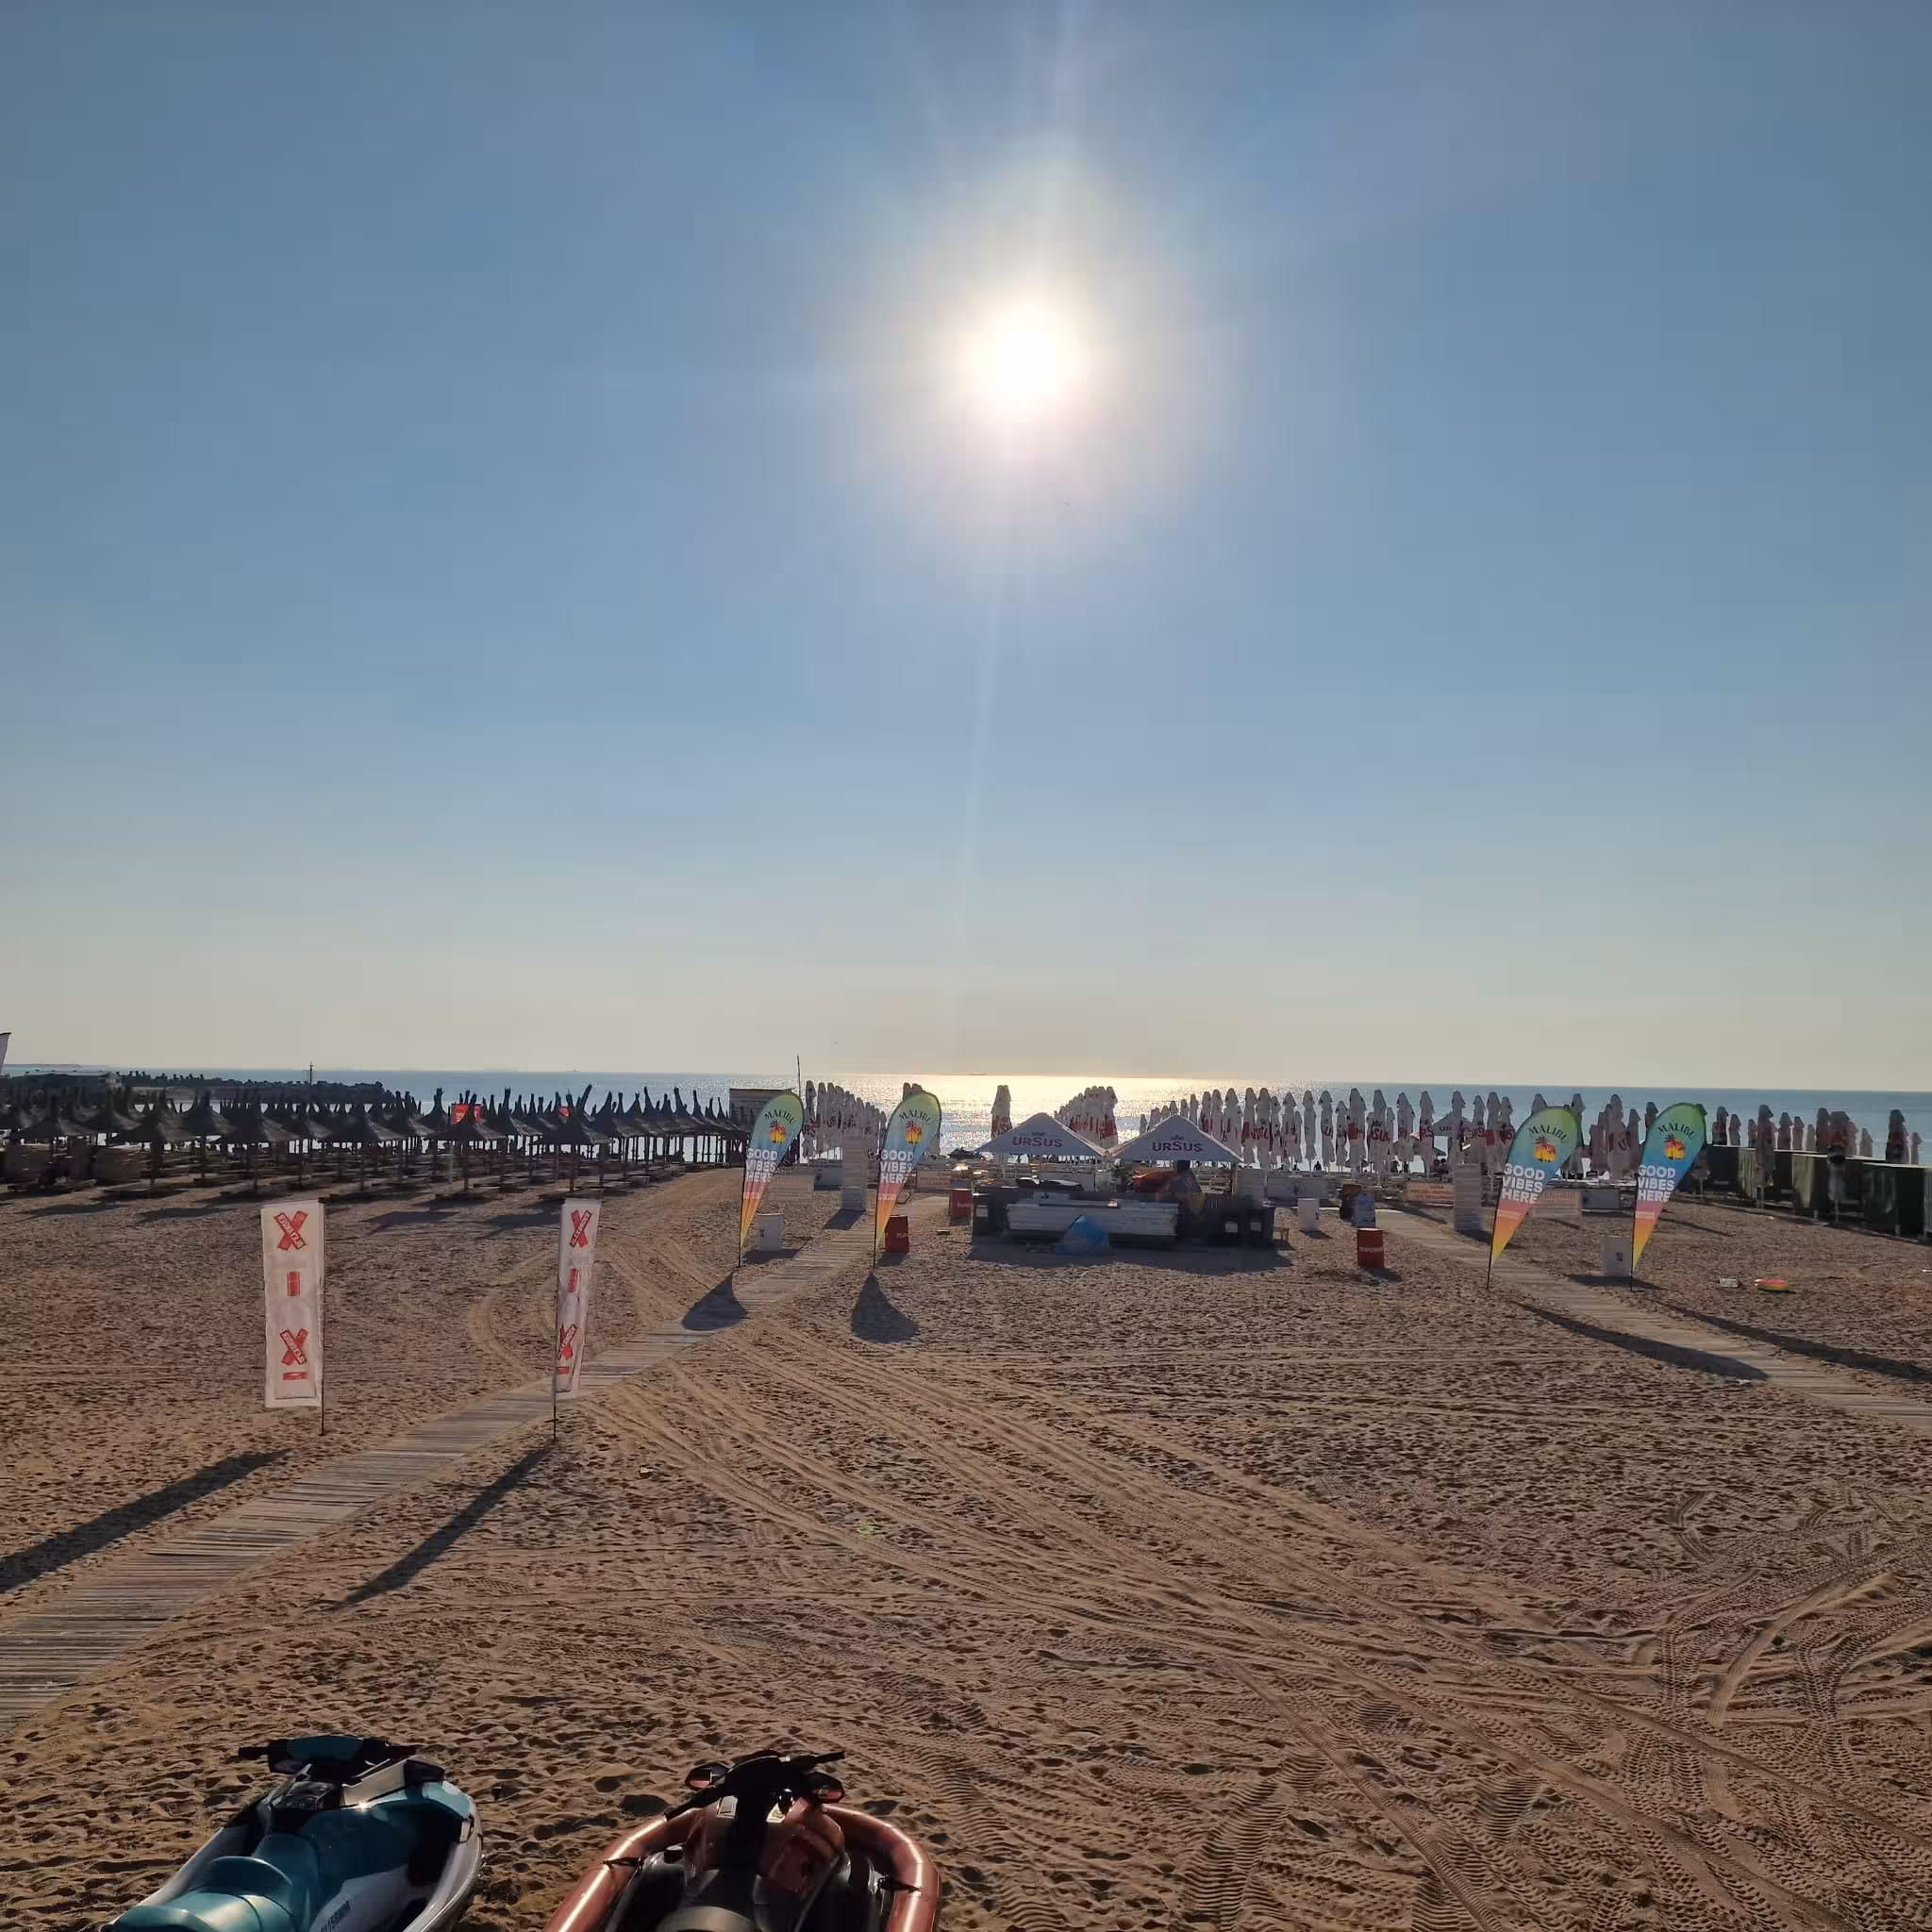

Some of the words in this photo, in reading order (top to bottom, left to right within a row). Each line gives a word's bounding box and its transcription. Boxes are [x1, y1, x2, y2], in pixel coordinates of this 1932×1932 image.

[764, 1108, 796, 1124] MALIBU
[899, 1109, 931, 1124] MALIBU
[1529, 1124, 1570, 1143] MALIBU
[1657, 1122, 1697, 1141] MALIBU
[1012, 1136, 1063, 1149] URSUS
[1152, 1141, 1204, 1153] URSUS
[746, 1148, 778, 1160] GOOD
[881, 1149, 914, 1161] GOOD
[746, 1160, 777, 1173] VIBES
[880, 1161, 913, 1173] VIBES
[1504, 1163, 1545, 1181] GOOD
[1639, 1164, 1676, 1178] GOOD
[746, 1172, 774, 1183] HERE
[1502, 1175, 1543, 1193] VIBES
[1638, 1177, 1675, 1191] VIBES
[1502, 1189, 1540, 1205] HERE
[1637, 1190, 1672, 1203] HERE
